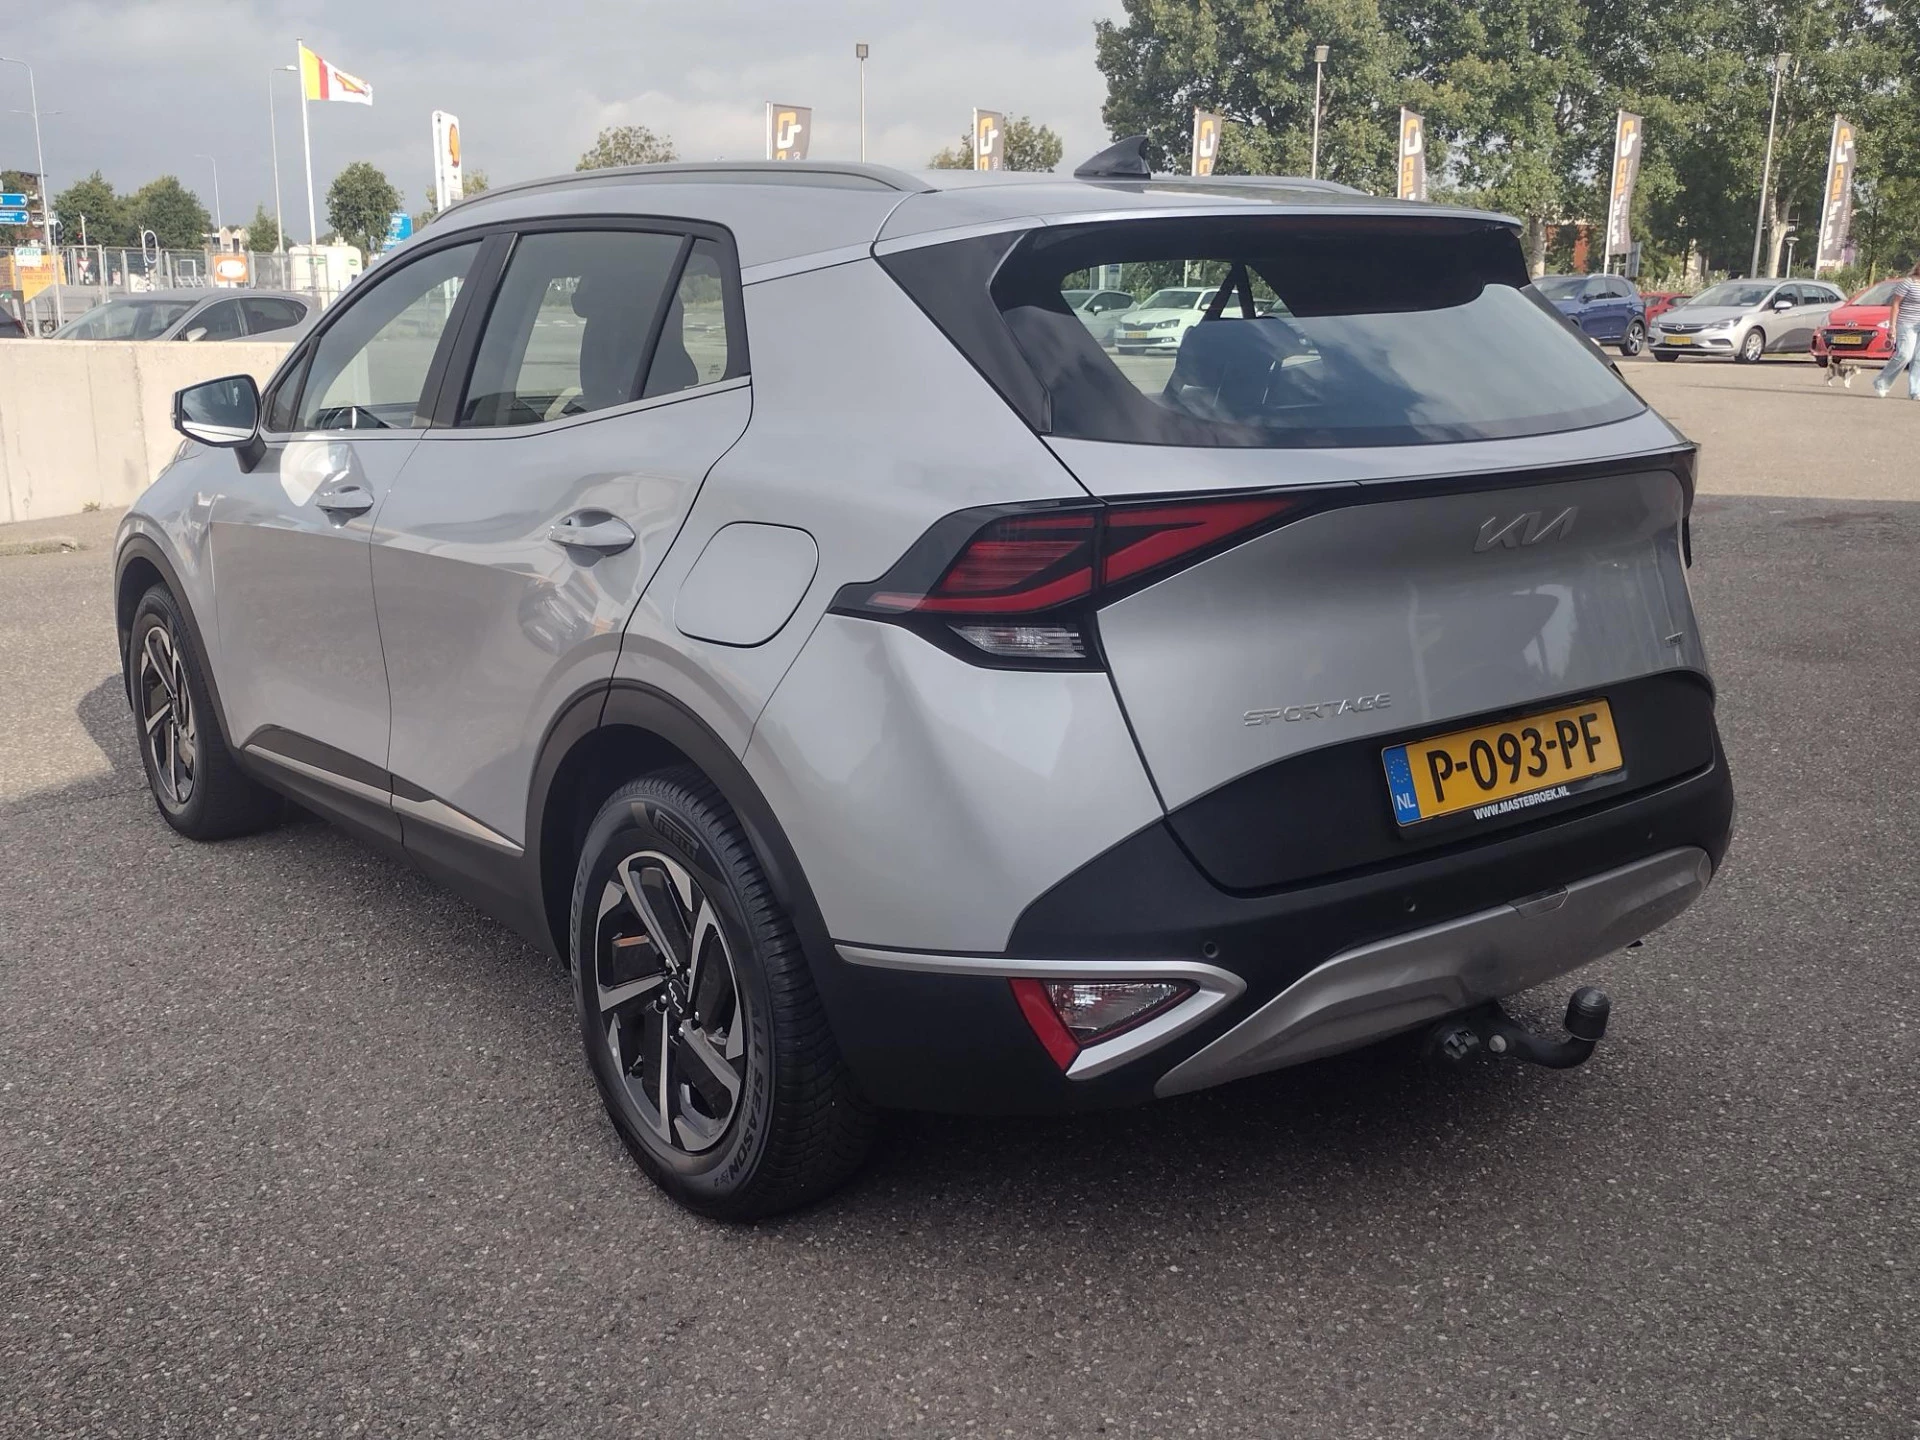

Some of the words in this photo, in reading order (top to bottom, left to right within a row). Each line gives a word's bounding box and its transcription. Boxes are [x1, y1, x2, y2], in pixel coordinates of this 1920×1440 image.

[1474, 506, 1578, 552] KIA
[1244, 693, 1391, 727] SPORTAGE
[1426, 712, 1602, 803] P-093-PF
[1397, 794, 1416, 811] NL
[1474, 785, 1570, 820] WWW.MASTEBROEK.NL
[728, 1067, 763, 1180] SEASON
